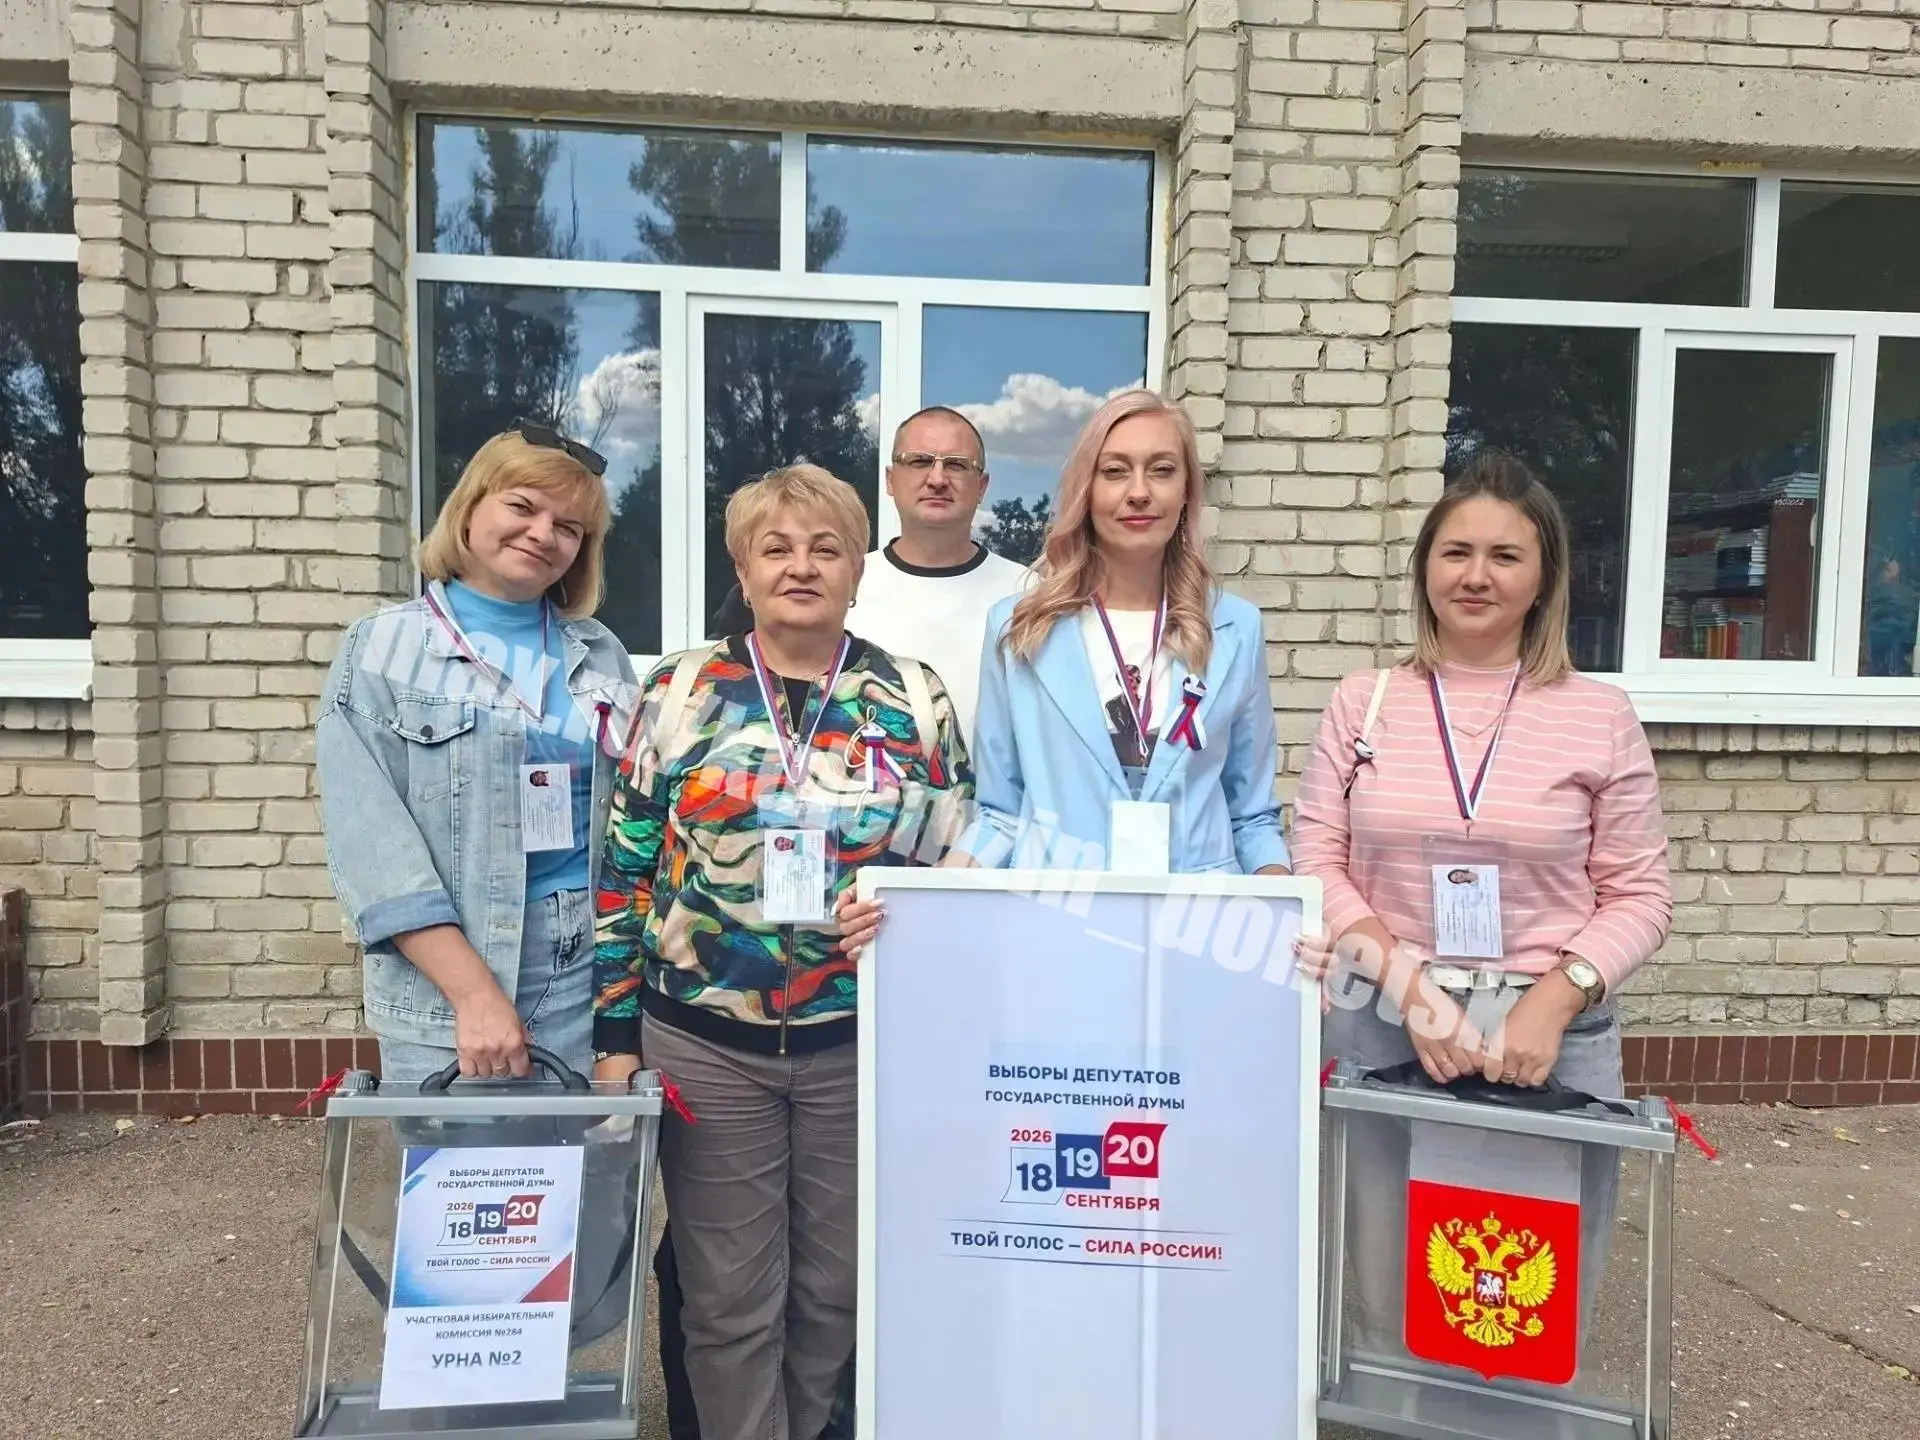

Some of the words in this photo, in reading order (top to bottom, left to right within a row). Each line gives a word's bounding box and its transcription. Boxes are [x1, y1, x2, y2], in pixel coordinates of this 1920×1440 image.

[989, 1065, 1068, 1081] ВЫБОРЫ
[1072, 1068, 1181, 1085] ДЕПУТАТОВ
[985, 1090, 1134, 1108] ГОСУДАРСТВЕННОЙ
[1137, 1097, 1185, 1110] ДУМЫ
[1011, 1129, 1052, 1143] 2026
[1016, 1162, 1053, 1192] 18
[1061, 1147, 1099, 1178] 19
[1107, 1134, 1155, 1166] 20
[449, 1169, 490, 1177] ВЫБОРЫ
[491, 1167, 545, 1177] ДЕПУТАТОВ
[437, 1179, 525, 1189] ГОСУДАРСТВЕННОЙ
[526, 1179, 555, 1188] ДУМЫ
[447, 1202, 474, 1211] 2026
[1065, 1193, 1160, 1211] СЕНТЯБРЯ
[448, 1221, 472, 1239] 18
[478, 1211, 501, 1228] 19
[506, 1201, 537, 1219] 20
[478, 1235, 537, 1245] СЕНТЯБРЯ
[950, 1230, 999, 1247] ТВОЙ
[1003, 1234, 1064, 1251] ГОЛОС
[1085, 1239, 1136, 1255] СИЛА
[1141, 1242, 1222, 1260] РОССИИ!
[426, 1257, 449, 1267] ТВОЙ
[451, 1258, 480, 1266] ГОЛОС
[490, 1257, 514, 1265] СИЛА
[515, 1255, 551, 1264] РОССИИ
[406, 1314, 470, 1325] УЧАСТКОВАЯ
[472, 1311, 554, 1322] ИЗБИРАТЕЛЬНАЯ
[436, 1329, 492, 1339] КОМИССИЯ
[431, 1351, 483, 1369] УРНА
[488, 1349, 522, 1367] №2
